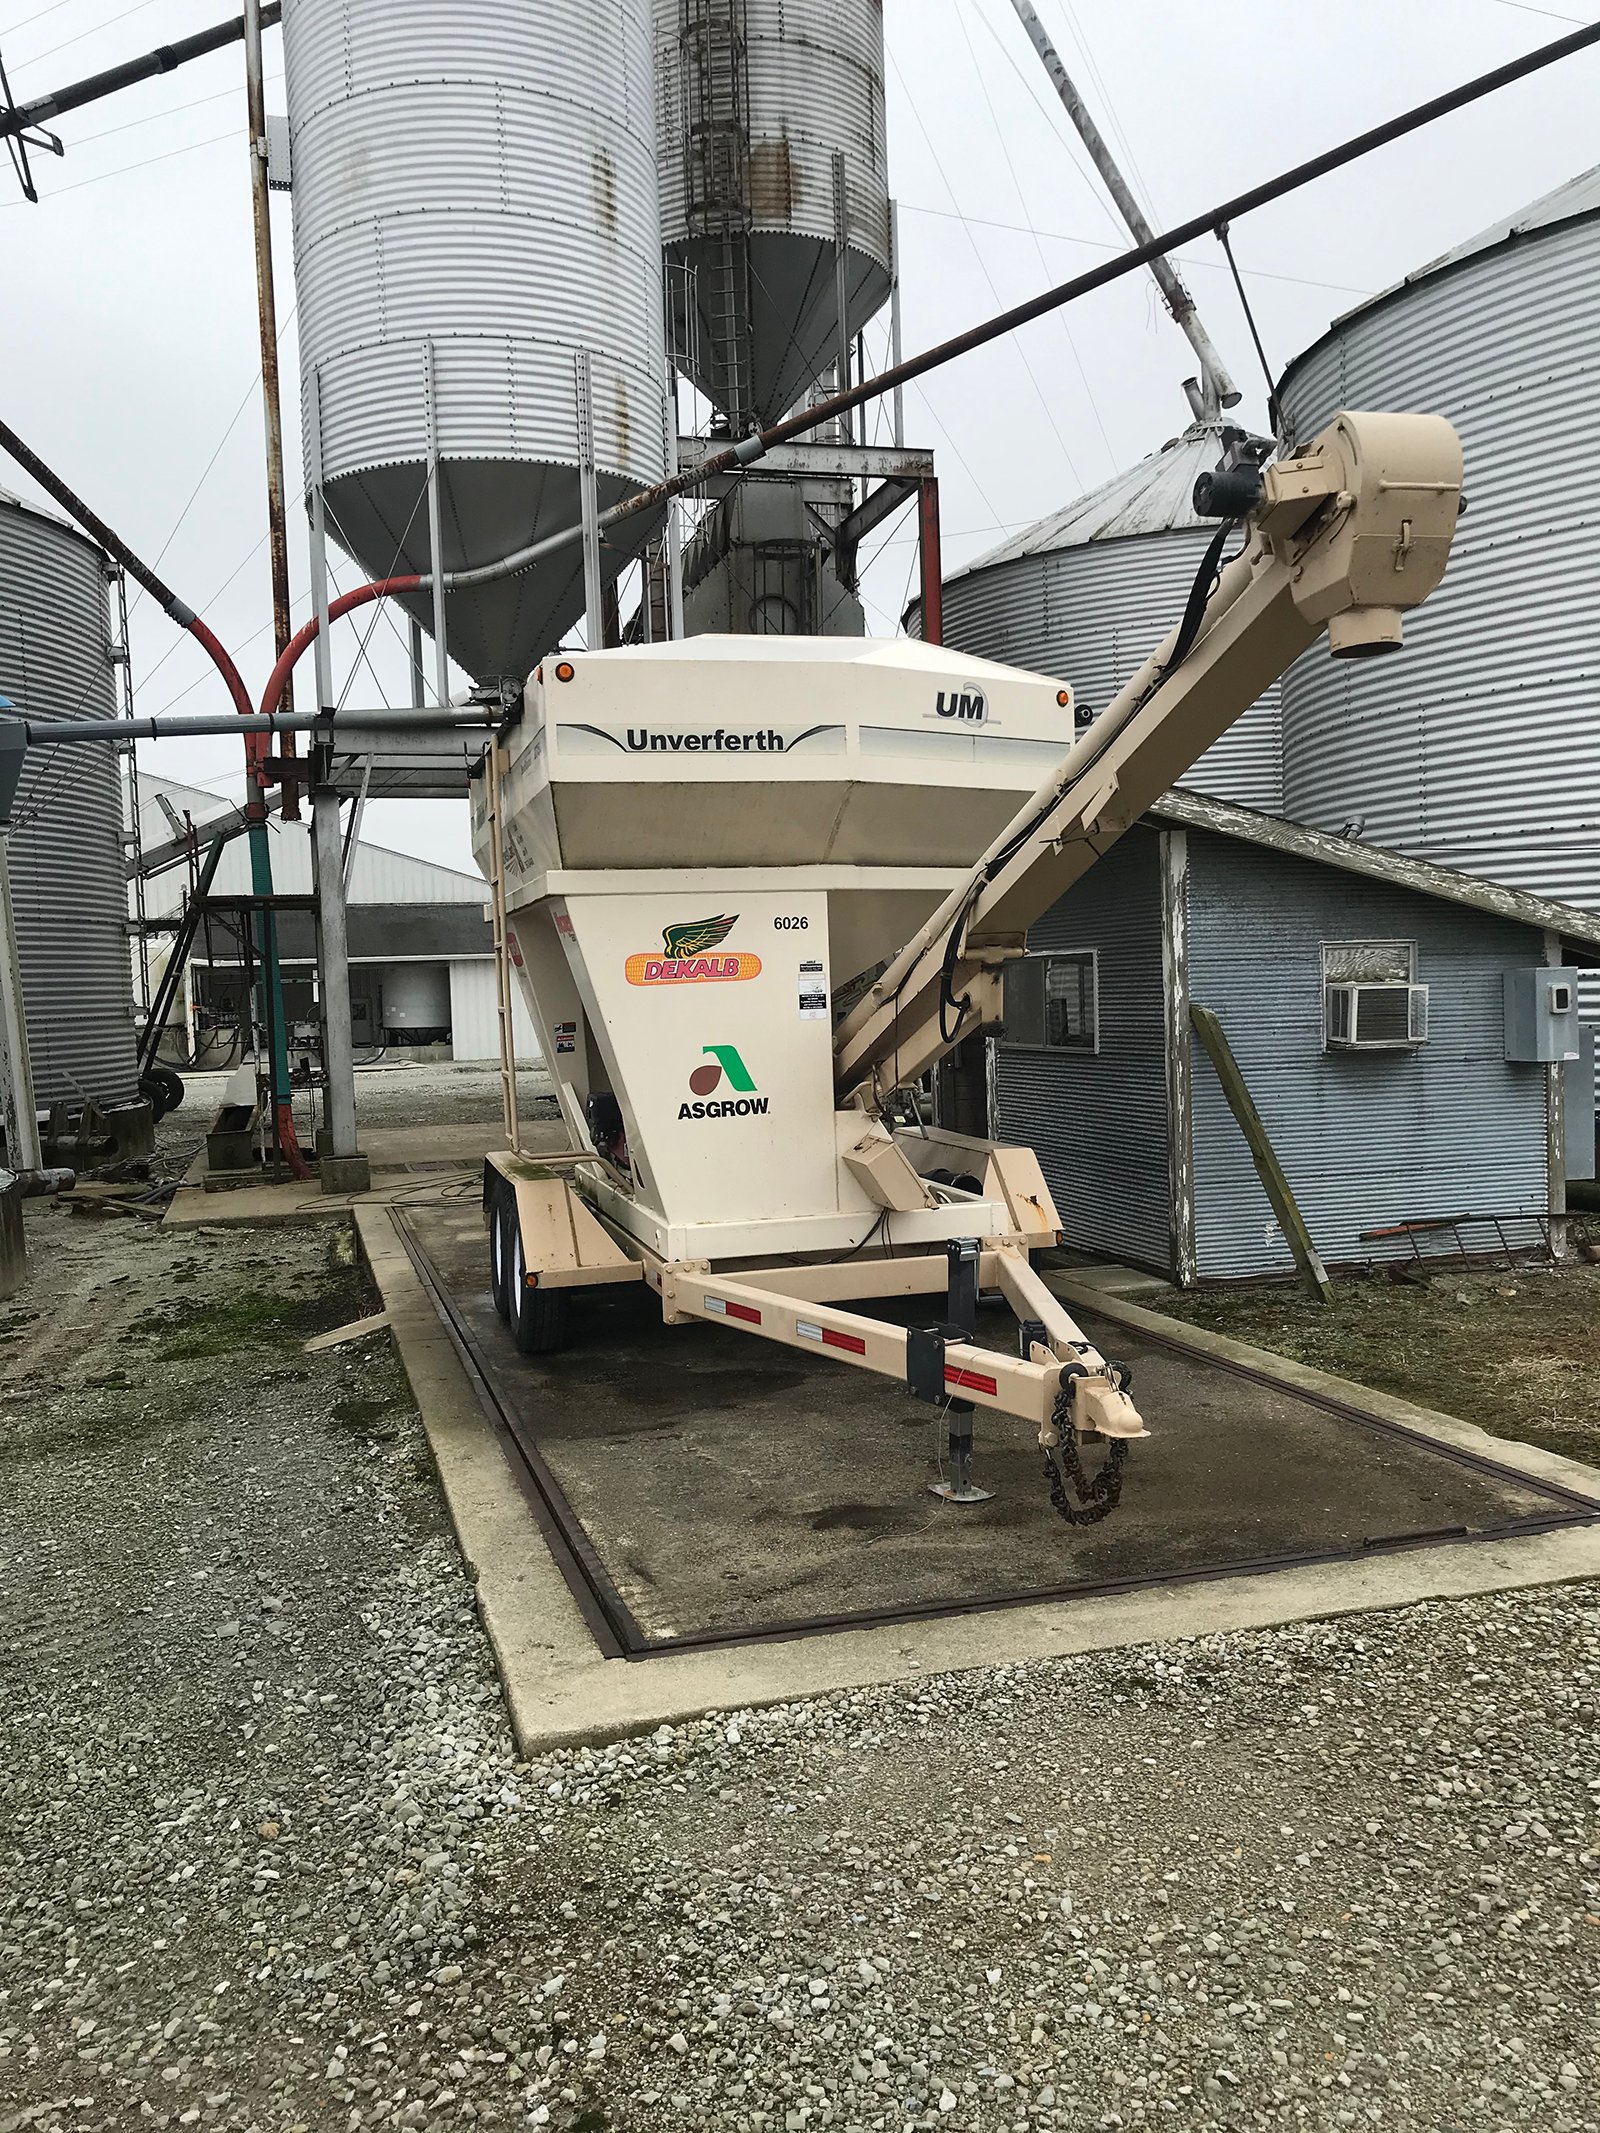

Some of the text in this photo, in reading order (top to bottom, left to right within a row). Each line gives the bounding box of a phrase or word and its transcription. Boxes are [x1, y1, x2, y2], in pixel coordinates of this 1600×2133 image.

[935, 692, 984, 720] UM
[627, 729, 785, 751] Unverferth
[773, 916, 809, 930] 6026
[644, 958, 740, 981] DEKALB
[677, 1097, 769, 1120] ASGROW
